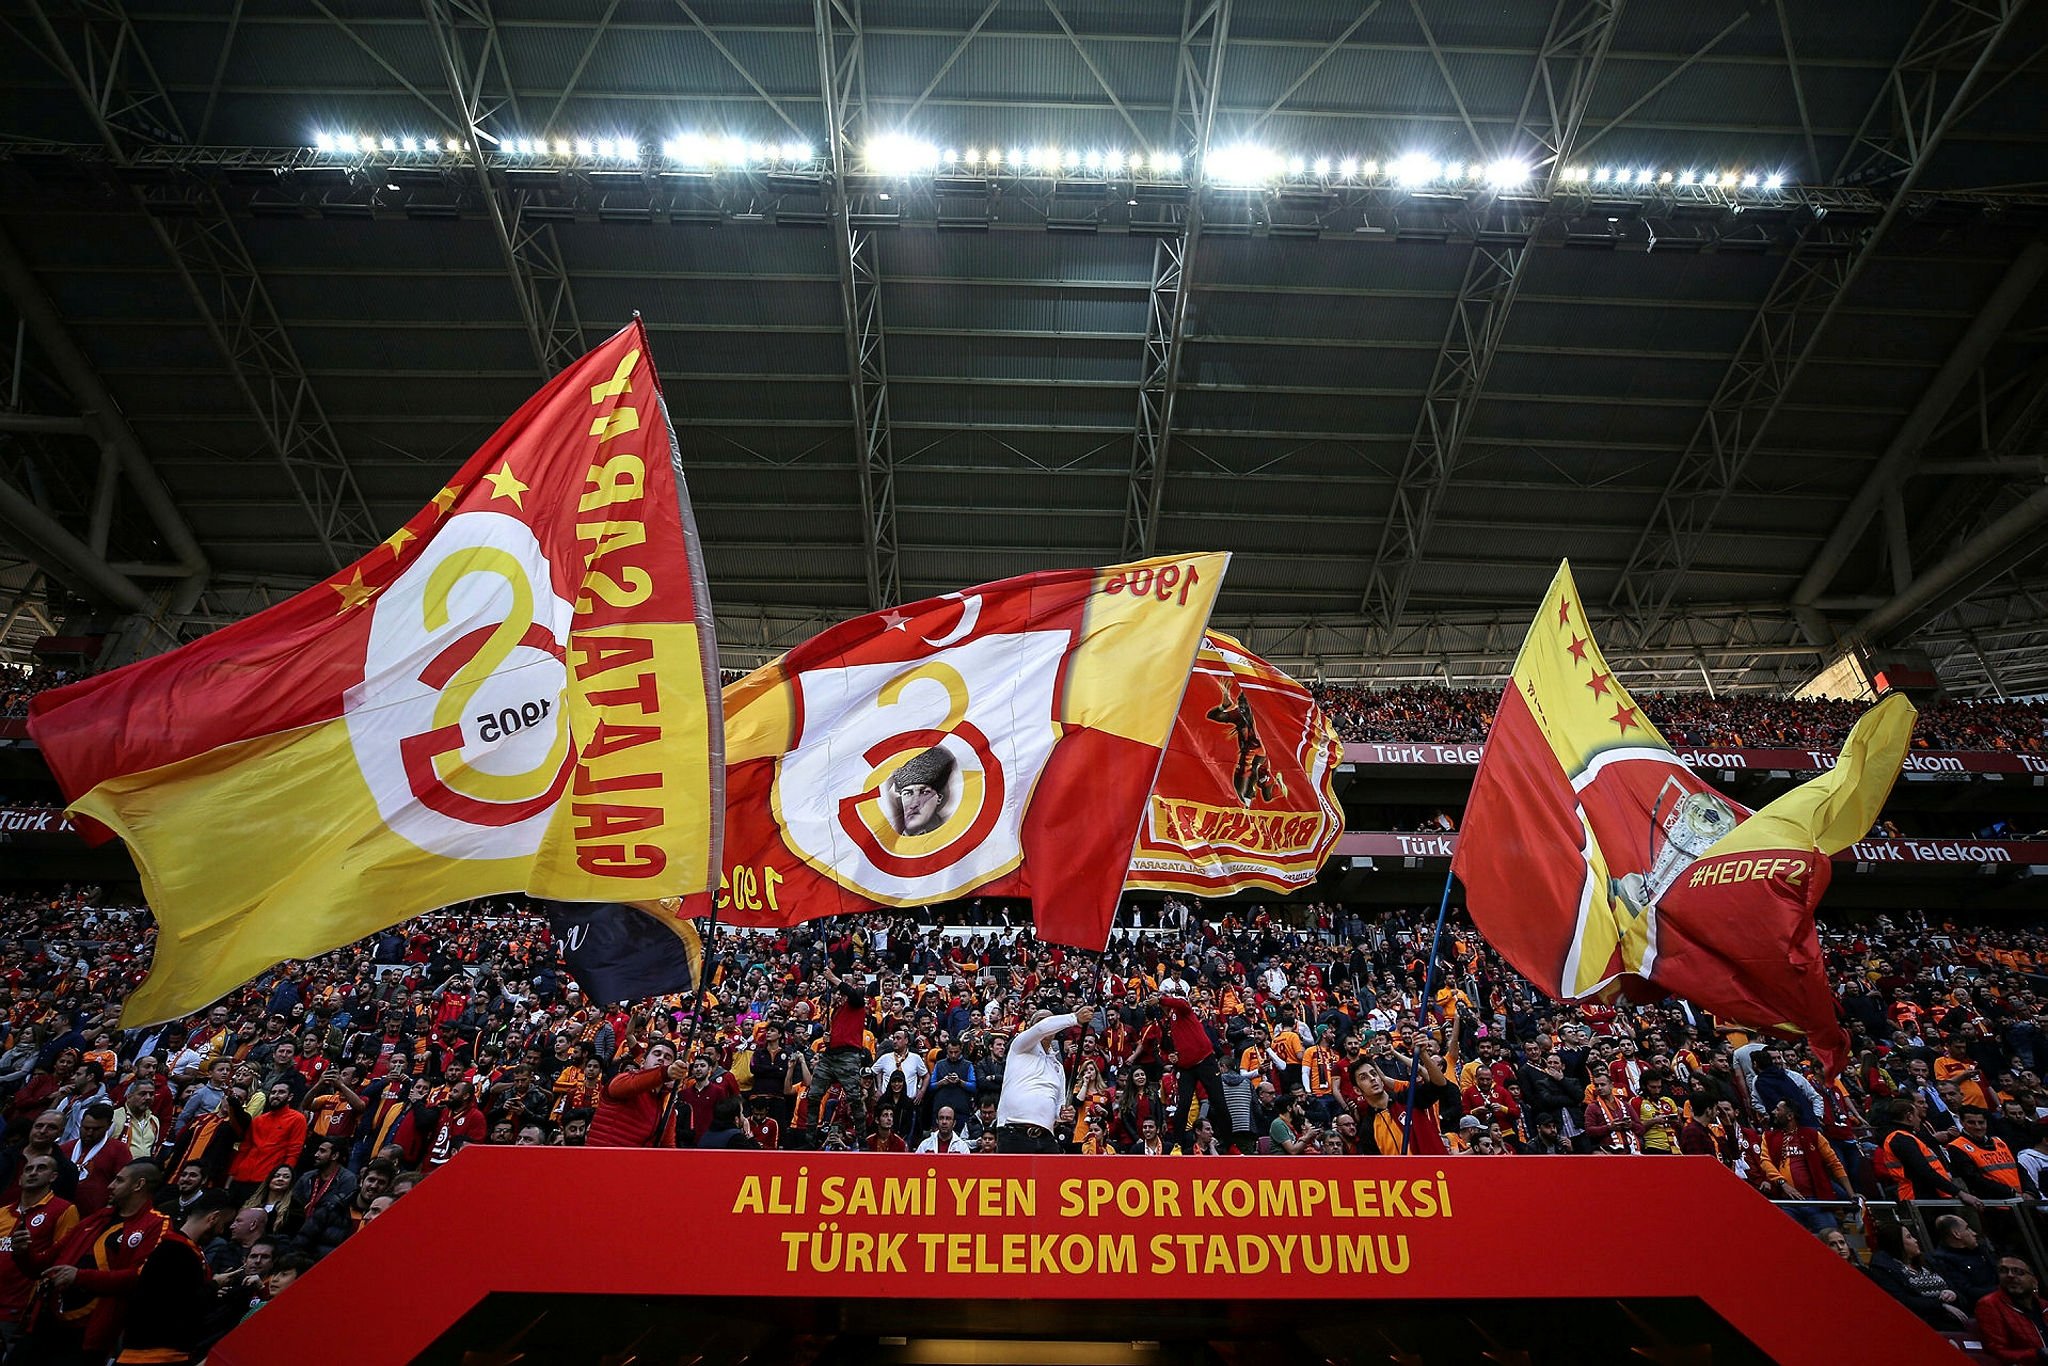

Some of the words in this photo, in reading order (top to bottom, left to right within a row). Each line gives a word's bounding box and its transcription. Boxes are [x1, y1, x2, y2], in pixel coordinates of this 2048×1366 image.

[1372, 745, 1426, 763] Türk
[1679, 750, 1747, 767] ekom
[1807, 751, 1838, 769] Tü
[0, 811, 53, 831] Türk
[1396, 836, 1453, 855] Türk
[1850, 842, 1904, 861] Türk
[1905, 842, 2012, 862] Telekom
[731, 1166, 809, 1215] ALİ
[818, 1168, 937, 1216] SAMİ
[947, 1178, 1036, 1217] YEN
[1059, 1178, 1182, 1218] SPOR
[1192, 1170, 1453, 1218] KOMPLEKSİ
[780, 1221, 908, 1273] TÜRK
[917, 1233, 1138, 1275] TELEKOM
[1150, 1233, 1411, 1275] STADYUMU
